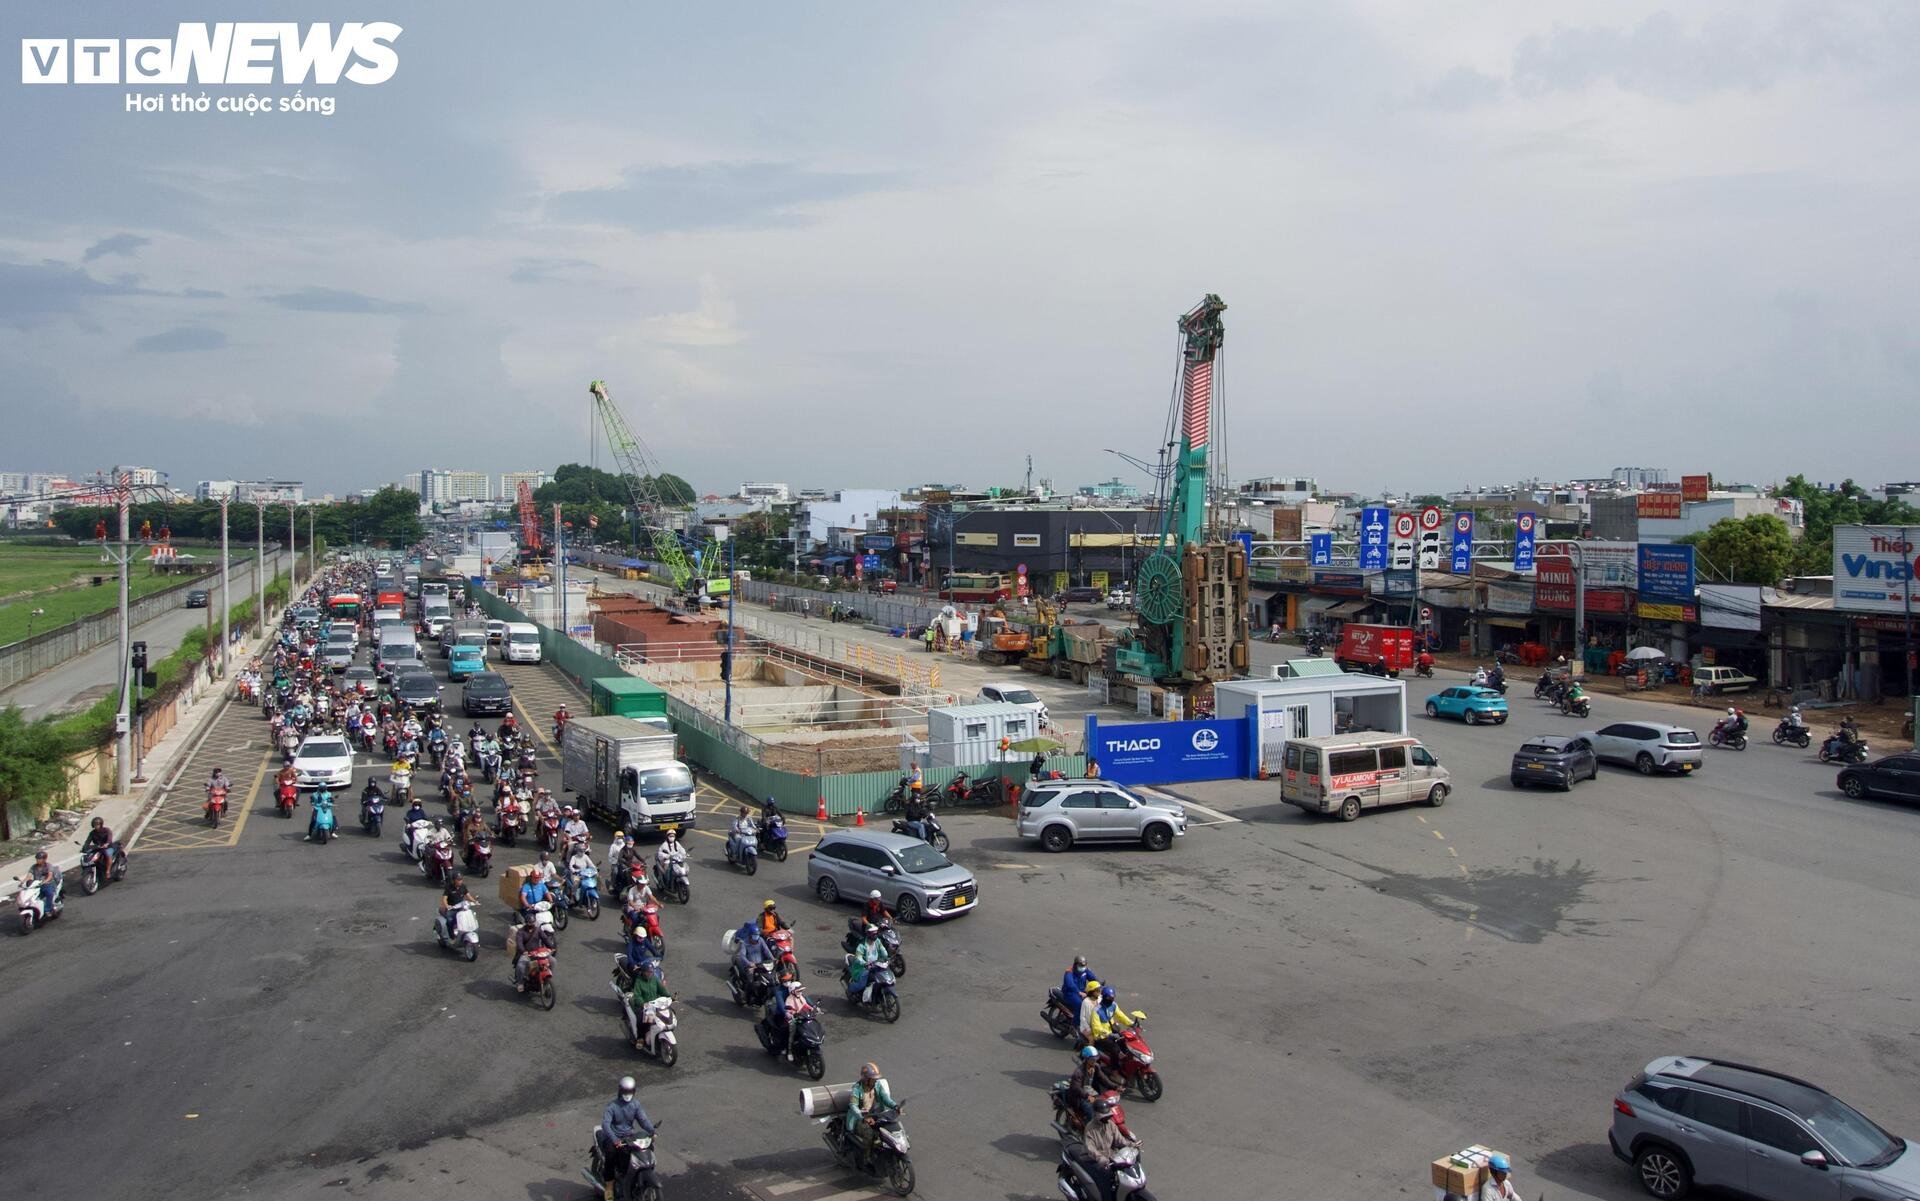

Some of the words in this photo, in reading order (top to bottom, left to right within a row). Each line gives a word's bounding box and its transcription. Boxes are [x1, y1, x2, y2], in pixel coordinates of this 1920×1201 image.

[1426, 513, 1436, 524] 60
[1459, 519, 1468, 529] 50
[1521, 518, 1530, 529] 50
[1400, 520, 1410, 531] 80
[1540, 572, 1570, 584] MINH
[1106, 738, 1161, 753] THACO
[1340, 774, 1376, 784] LALAMOVE
